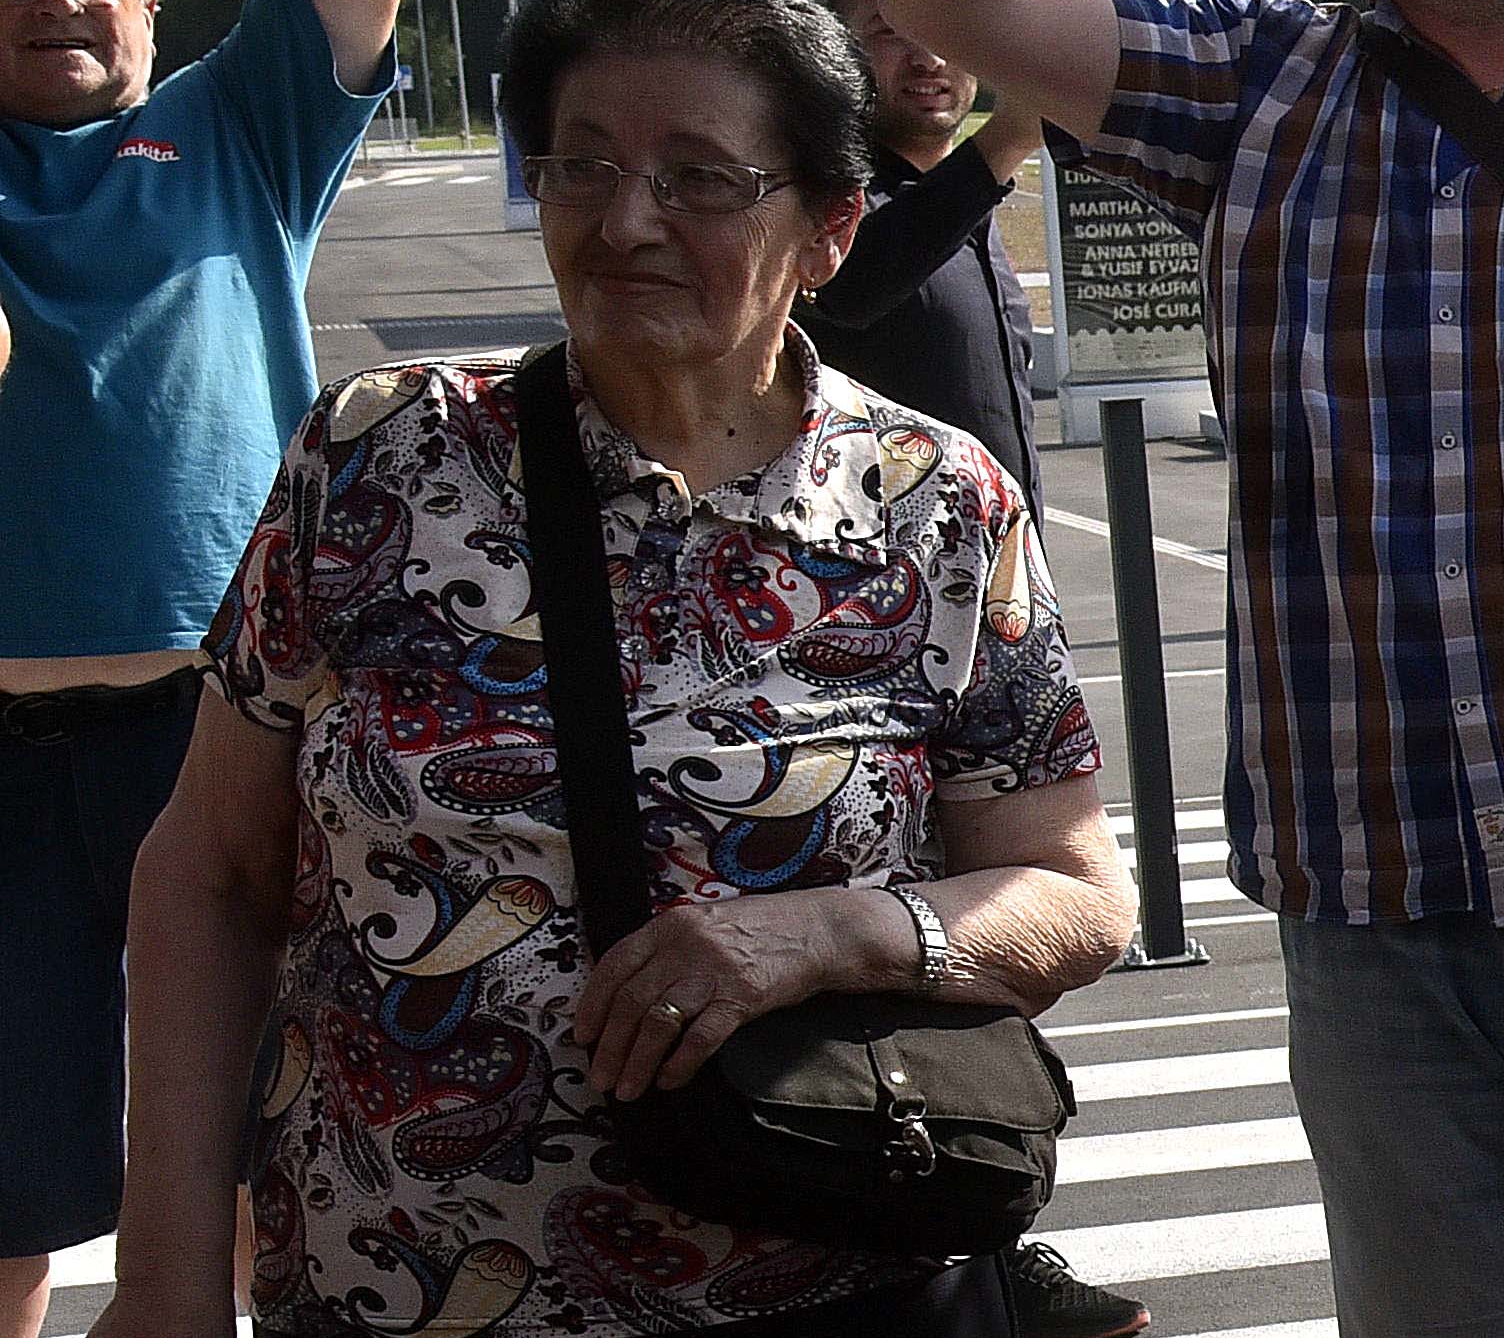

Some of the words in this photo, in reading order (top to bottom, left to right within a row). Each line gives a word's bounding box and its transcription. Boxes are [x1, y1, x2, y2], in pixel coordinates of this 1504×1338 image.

[1069, 200, 1143, 217] MARTHA
[1074, 222, 1134, 239] SONYA
[1085, 244, 1137, 261] ANNA
[1080, 263, 1094, 277] &
[1099, 261, 1144, 277] YUSIF
[1077, 283, 1133, 300] JONAS
[1137, 280, 1200, 298] KAUFM
[1112, 302, 1151, 321] JOSÉ
[1155, 302, 1200, 318] CURA
